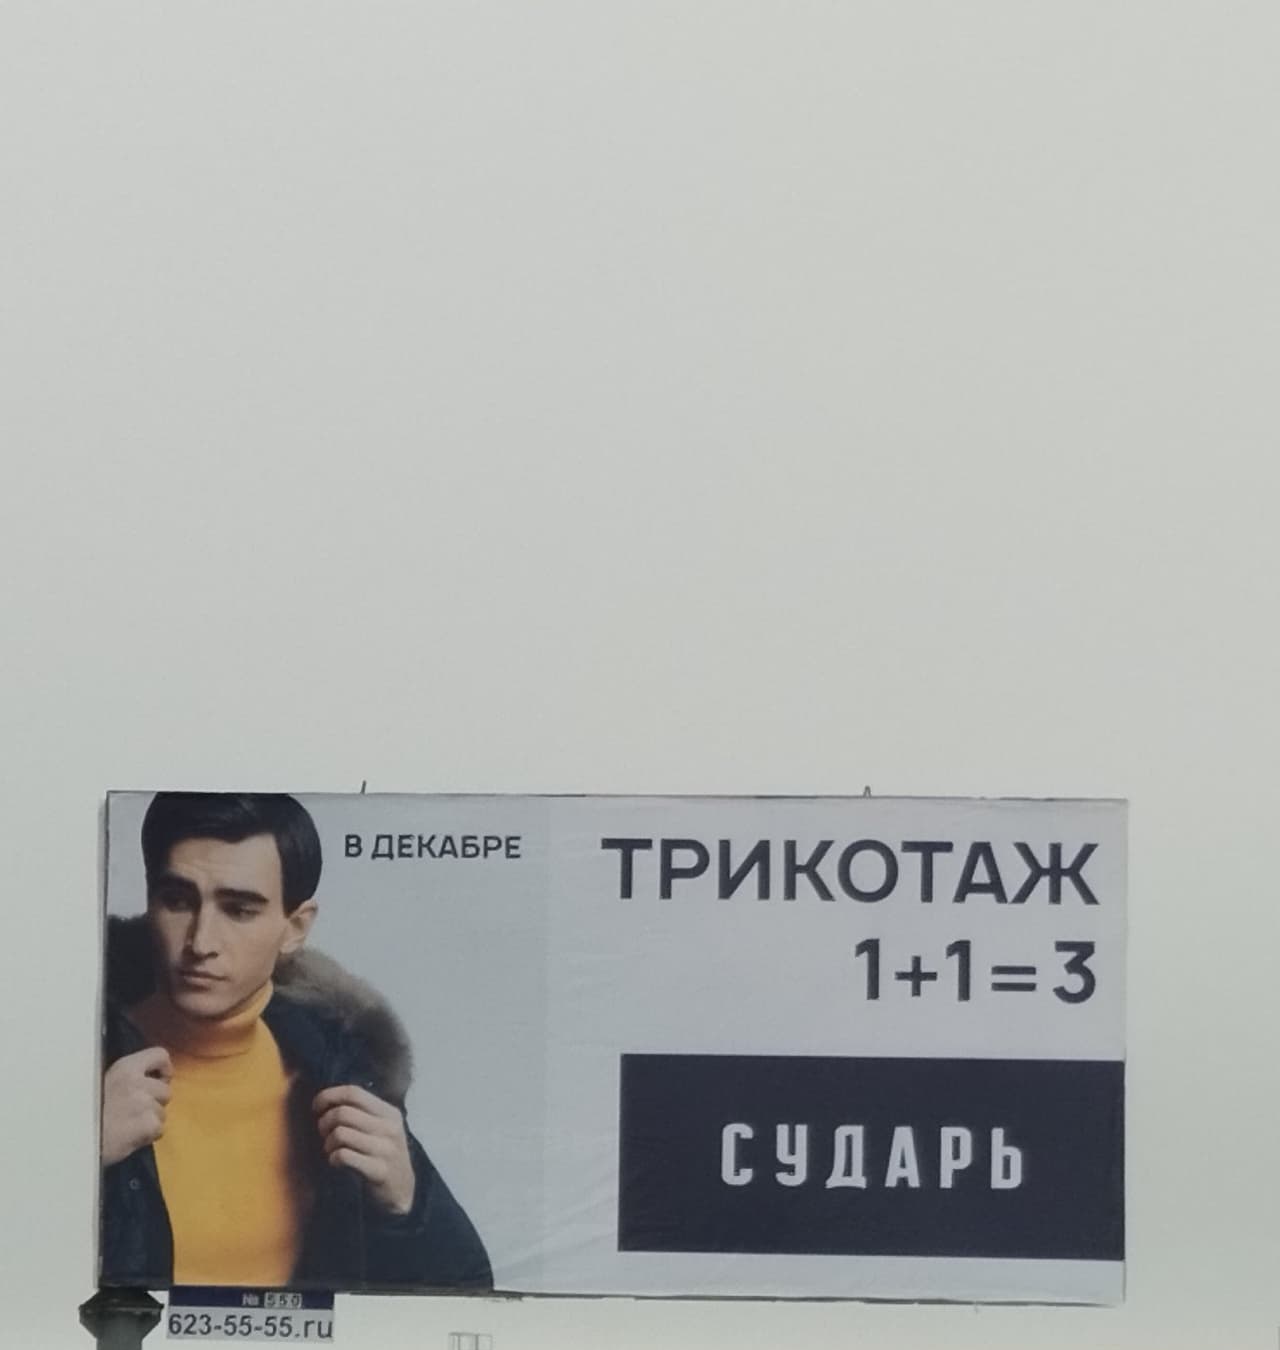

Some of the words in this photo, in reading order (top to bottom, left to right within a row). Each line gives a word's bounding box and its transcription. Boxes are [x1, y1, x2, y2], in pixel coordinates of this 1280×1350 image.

[344, 834, 363, 858] В
[371, 834, 522, 860] ДЕКАБРЕ
[600, 837, 1101, 906] ТРИКОТАЖ
[854, 938, 1097, 1004] 1+1=3
[721, 1123, 1023, 1189] СУДАРЬ
[168, 1313, 334, 1339] 623-55-55.ru
